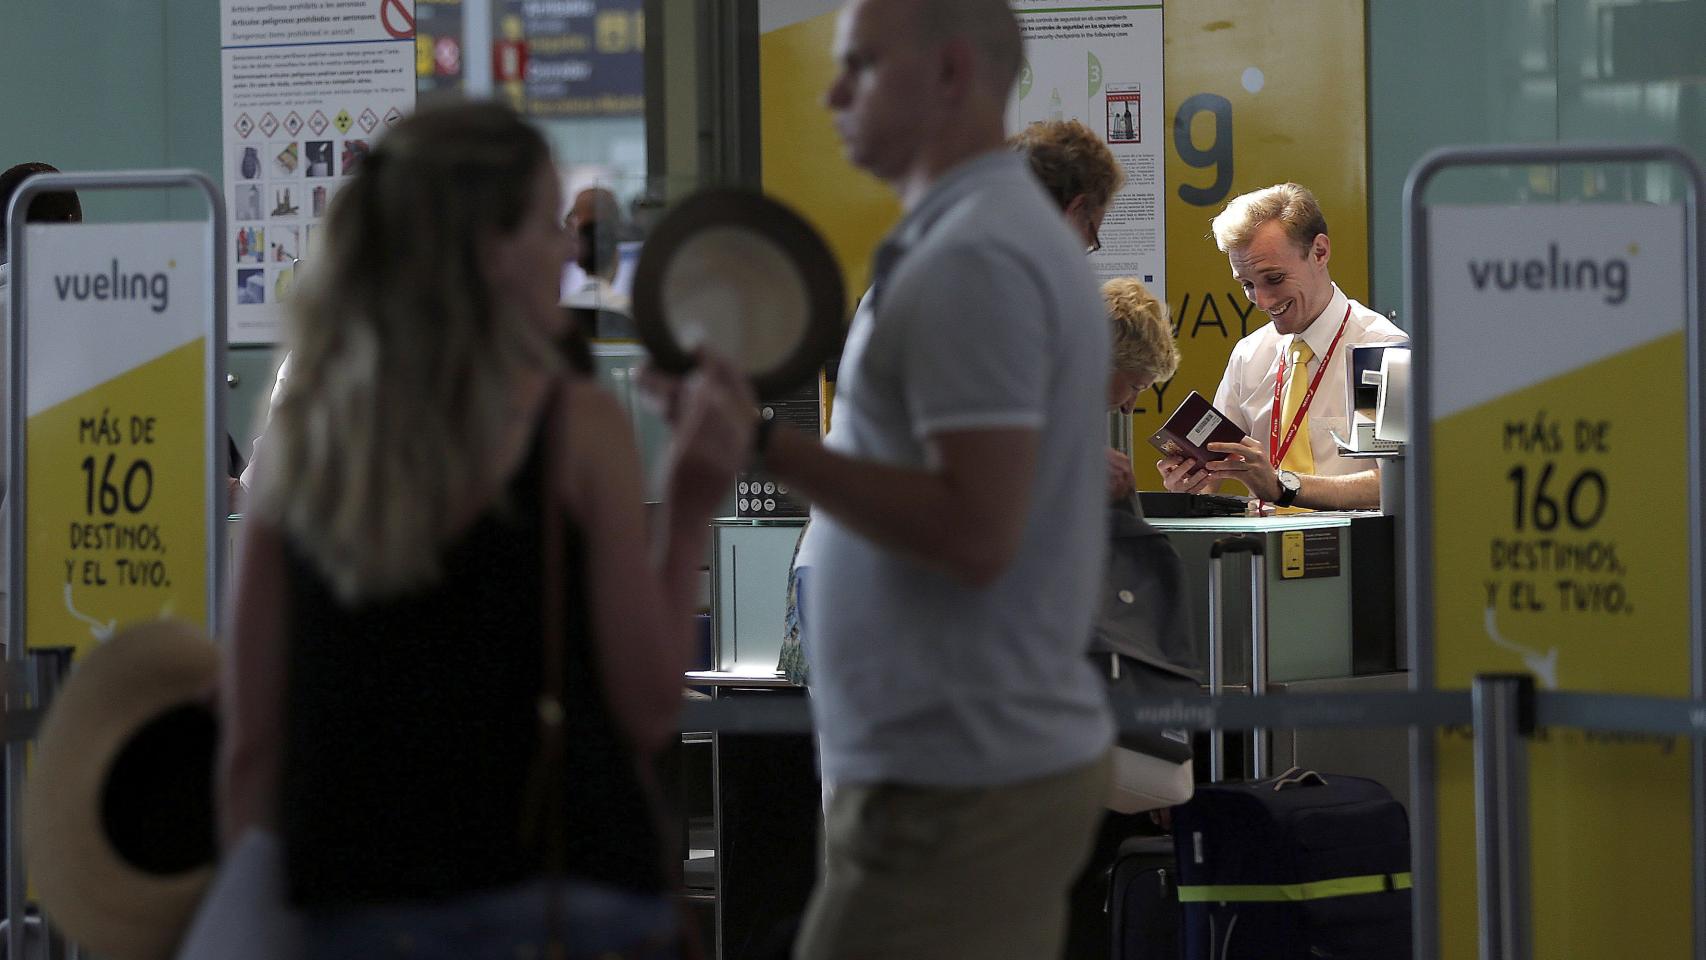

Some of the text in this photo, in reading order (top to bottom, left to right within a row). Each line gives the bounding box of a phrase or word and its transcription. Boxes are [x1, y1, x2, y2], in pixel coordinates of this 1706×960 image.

[1091, 64, 1101, 82] 3
[54, 257, 169, 314] vueling
[1468, 242, 1630, 307] vueling
[79, 408, 156, 445] MÁS DE
[1503, 410, 1611, 453] MÁS DE
[81, 453, 153, 516] 160
[1507, 460, 1608, 533] 160
[70, 522, 166, 554] DESTINOS,
[1490, 538, 1627, 577] DESTINOS,
[65, 558, 171, 588] Y EL TUYO.
[1484, 579, 1635, 615] Y EL TUYO.
